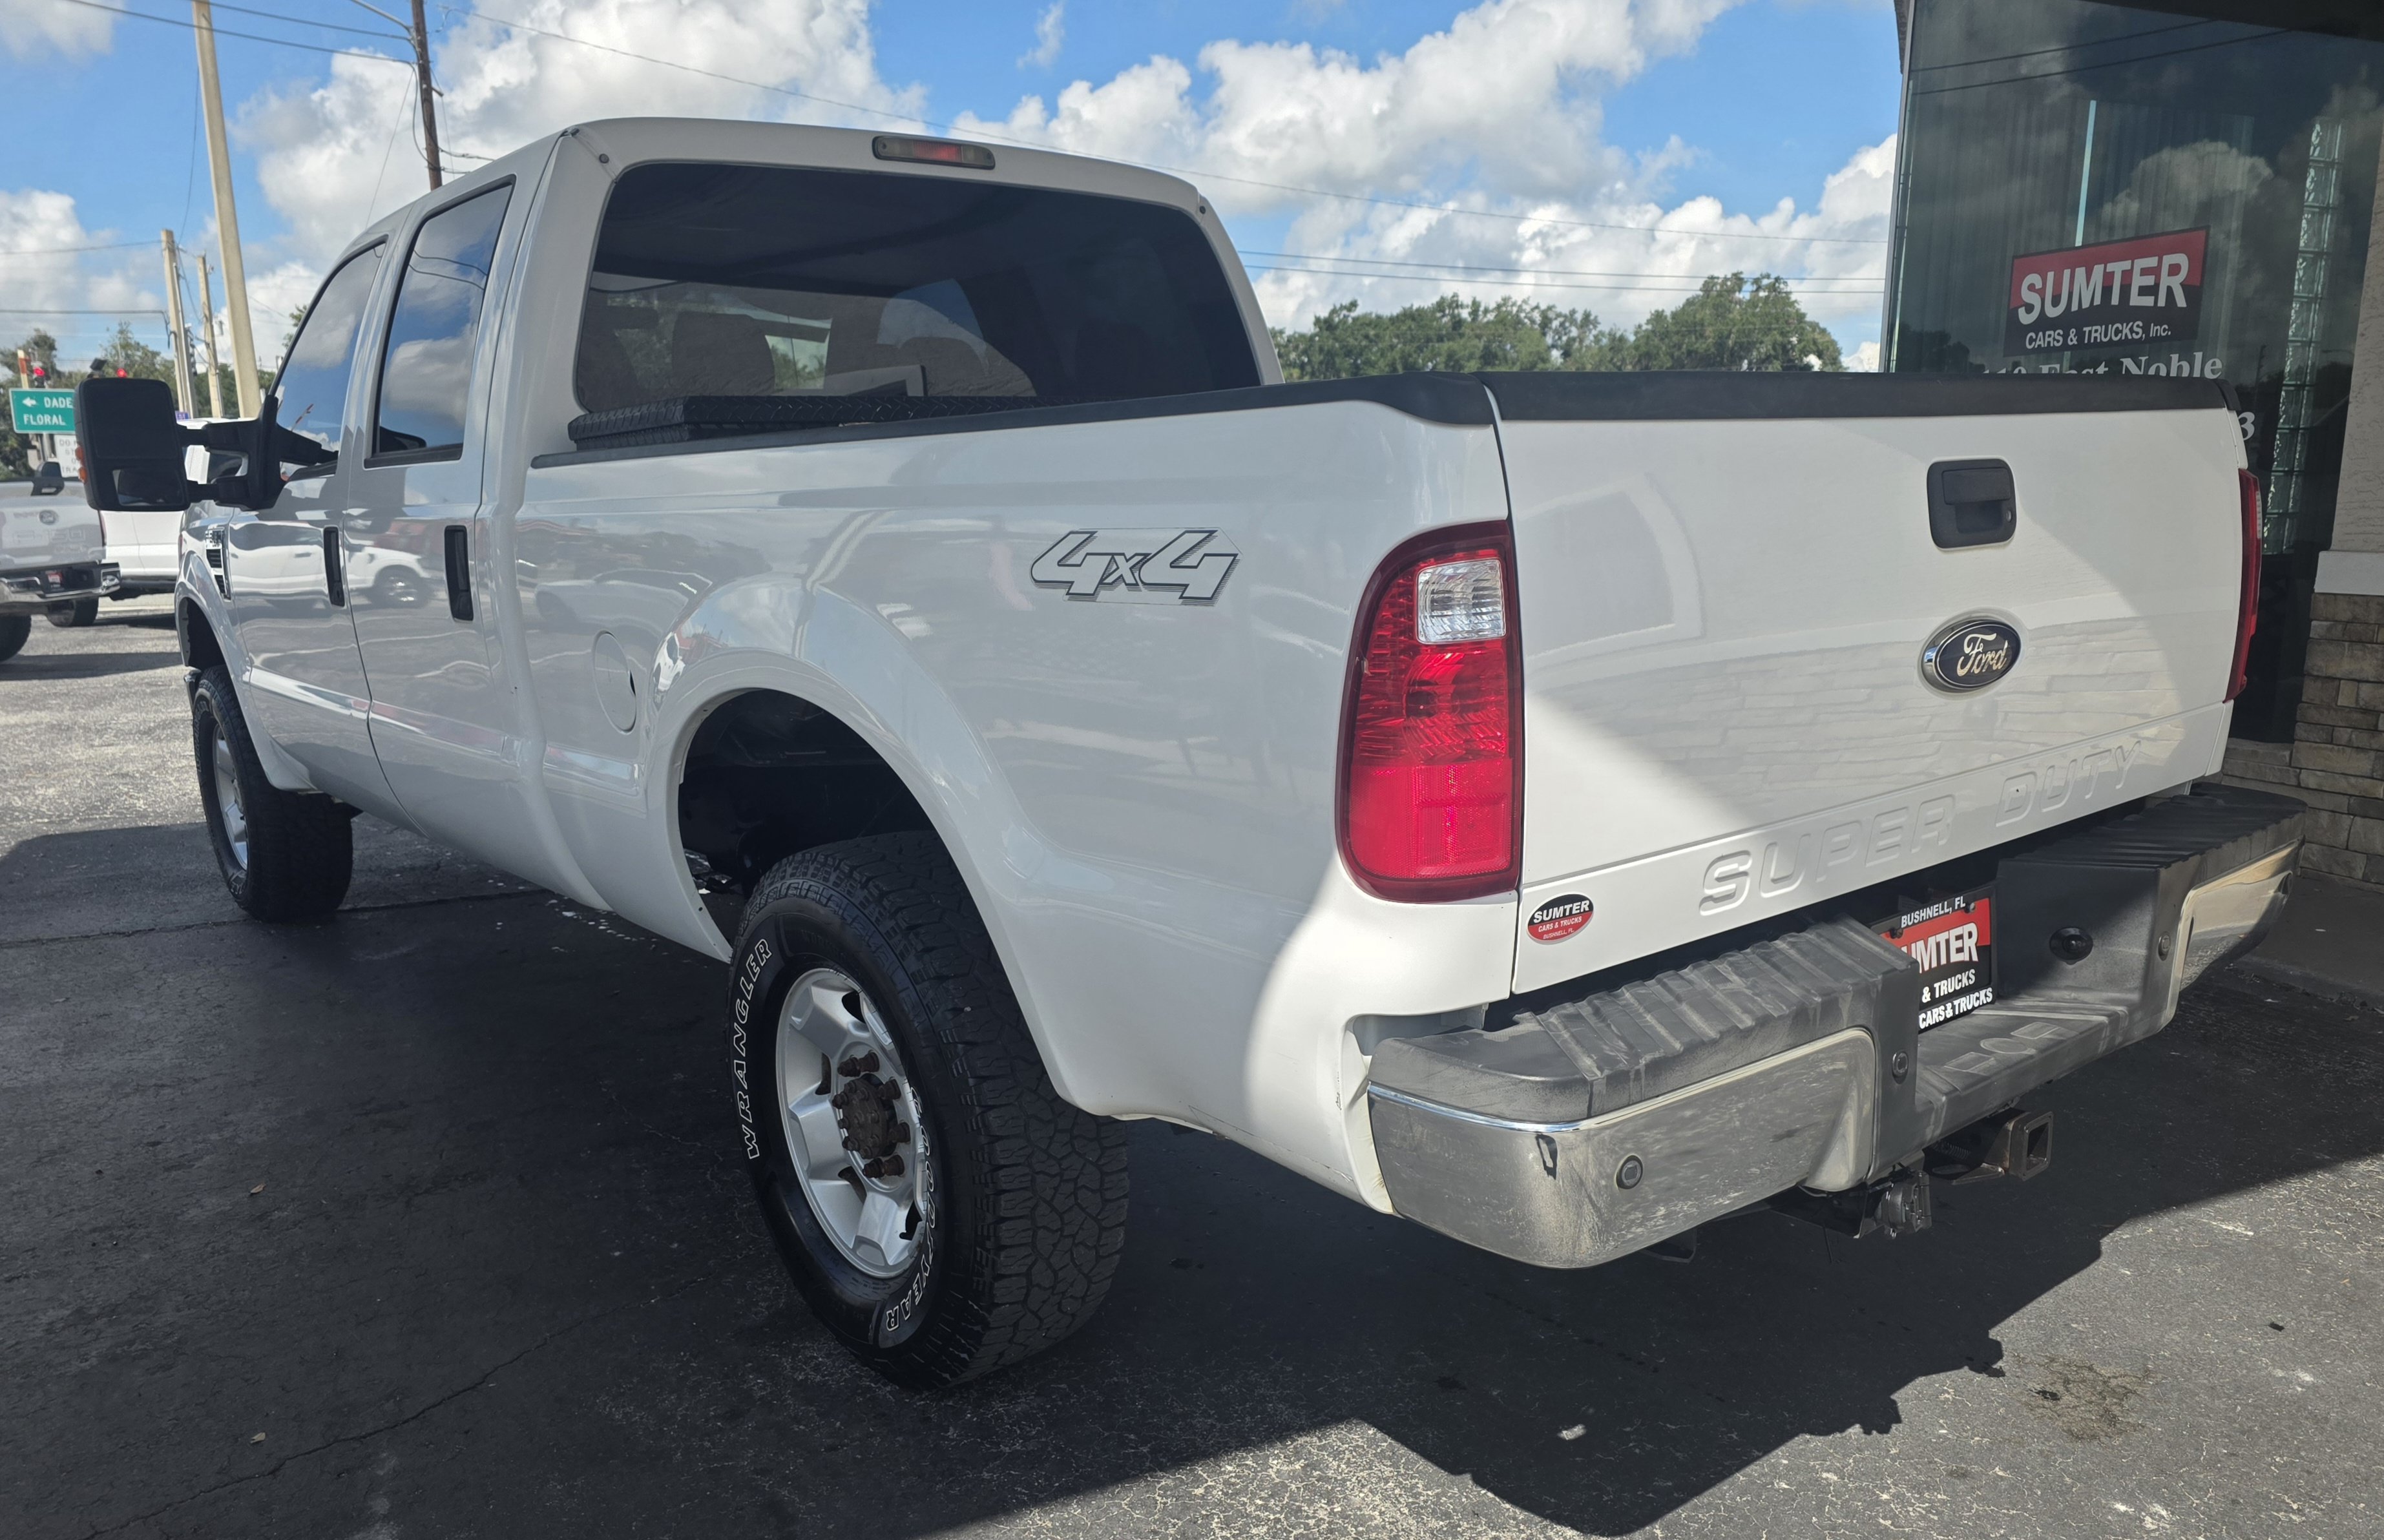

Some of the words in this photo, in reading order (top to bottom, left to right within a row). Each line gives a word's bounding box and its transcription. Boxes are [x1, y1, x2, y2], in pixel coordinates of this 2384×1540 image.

[2018, 253, 2189, 325] SUMTER
[2025, 329, 2064, 349] CARS
[2067, 328, 2078, 345] &
[2083, 321, 2146, 344] TRUCKS,
[2150, 324, 2171, 337] Inc.
[44, 397, 74, 408] DADE
[23, 414, 66, 425] FLORAL
[1030, 529, 1240, 605] 4x4
[1957, 632, 2009, 677] Ford
[1699, 793, 1956, 915] SUPER
[1994, 739, 2142, 827] DUTY
[1533, 900, 1589, 923] SUMTER
[1538, 923, 1554, 932] CARS
[1560, 916, 1582, 927] TRUCKS
[1901, 900, 1952, 928] BUSHNELL,
[1955, 896, 1966, 910] FL
[1921, 986, 1932, 1003] &
[1934, 969, 1976, 998] TRUCKS
[734, 939, 772, 1159] WRANGLER
